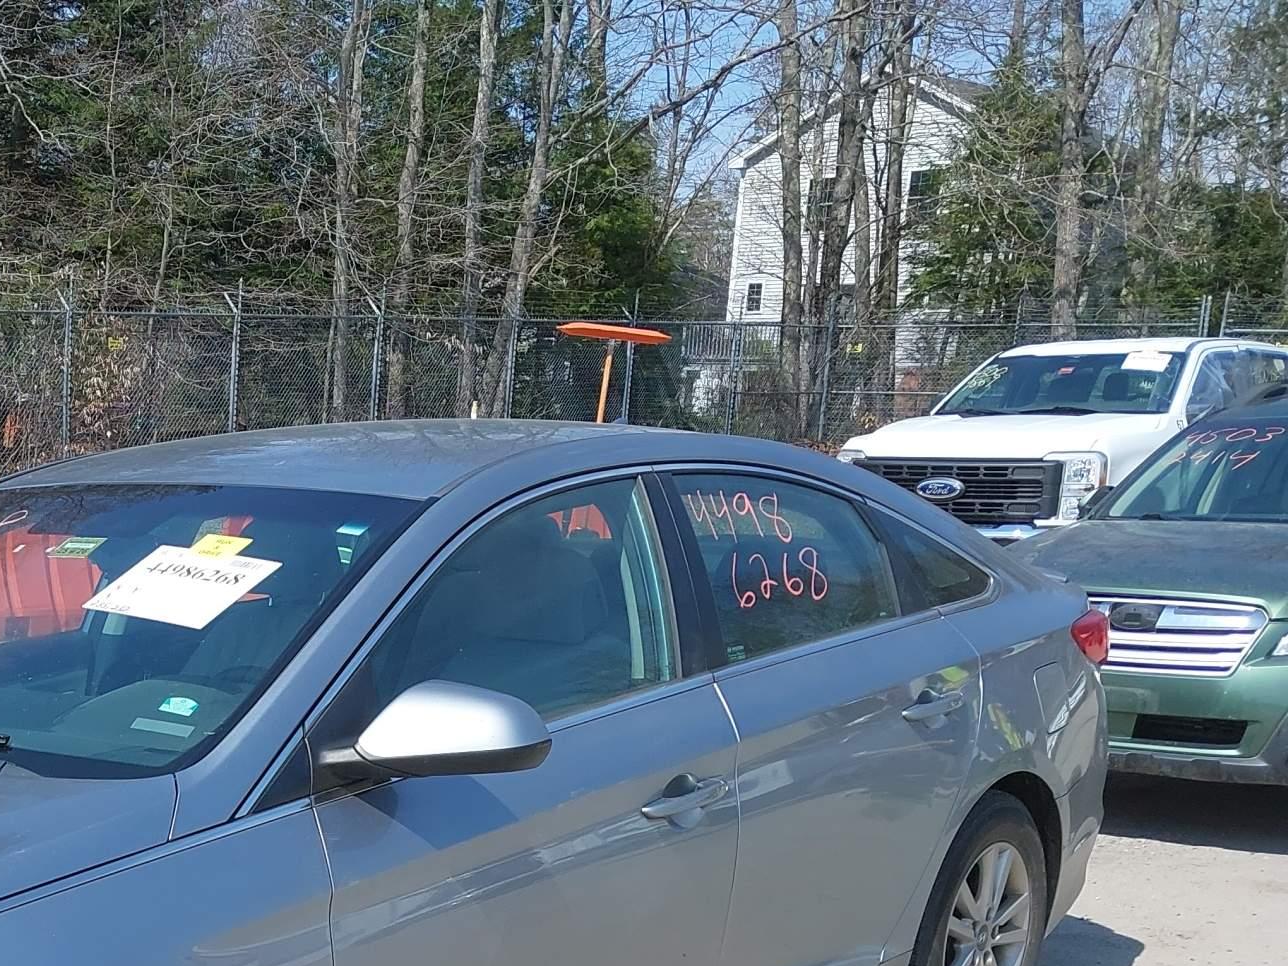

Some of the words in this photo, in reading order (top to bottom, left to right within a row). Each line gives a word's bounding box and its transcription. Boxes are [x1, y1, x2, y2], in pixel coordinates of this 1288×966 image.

[1185, 426, 1286, 447] 4503
[1169, 449, 1262, 471] 2414
[924, 482, 951, 496] Ford
[687, 488, 793, 544] 4498
[146, 561, 247, 587] 44986268
[731, 546, 828, 608] 6268
